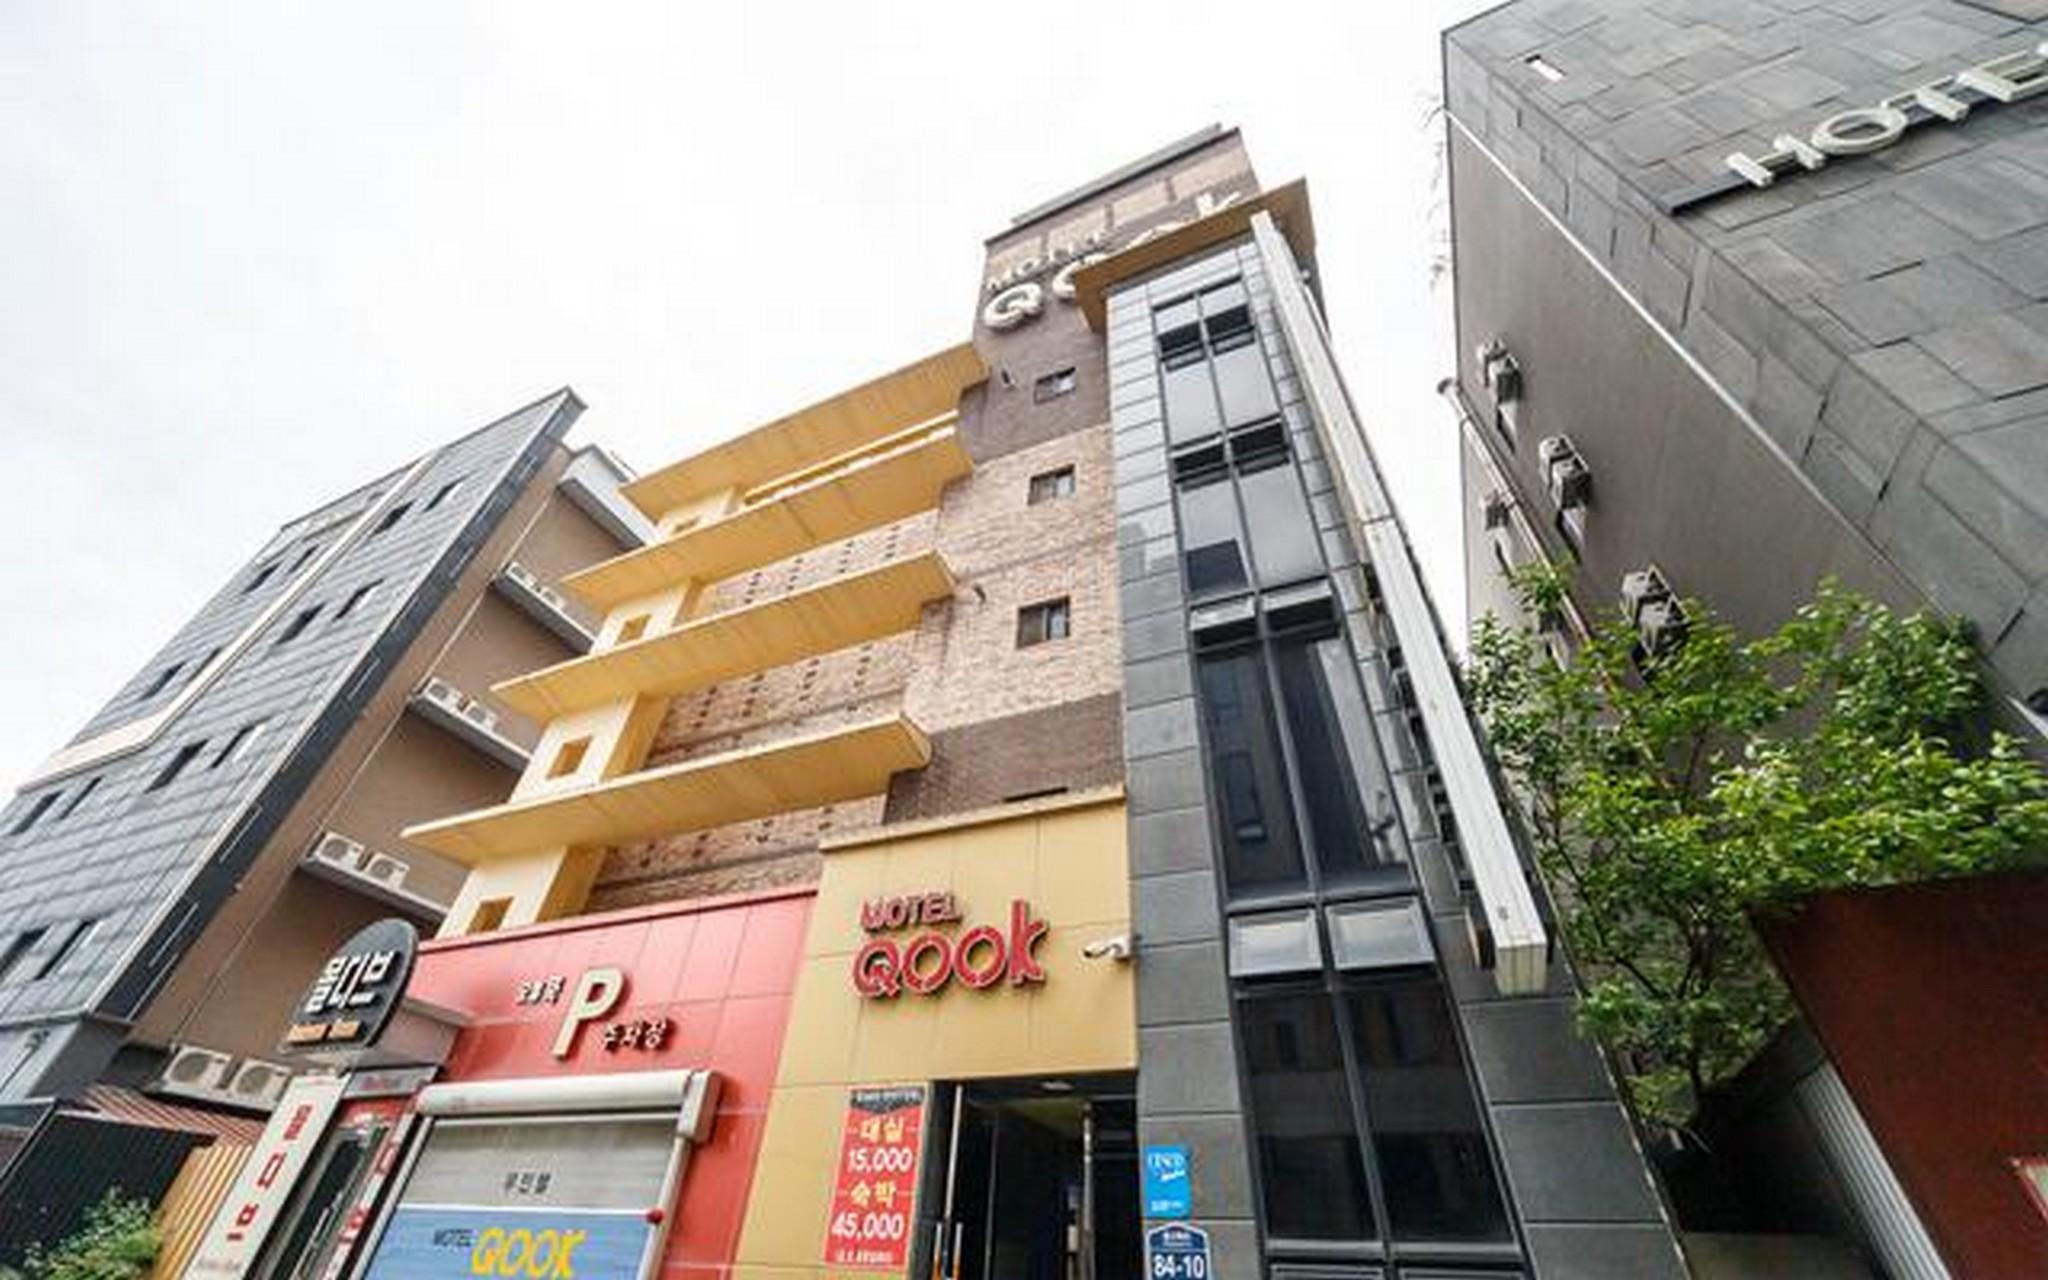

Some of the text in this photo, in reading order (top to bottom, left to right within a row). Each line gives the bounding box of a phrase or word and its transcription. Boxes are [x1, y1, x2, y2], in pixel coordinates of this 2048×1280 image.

[861, 890, 962, 932] MOTEL
[551, 967, 631, 1060] P
[859, 1115, 905, 1143] 대실
[1153, 1254, 1205, 1279] 84-10
